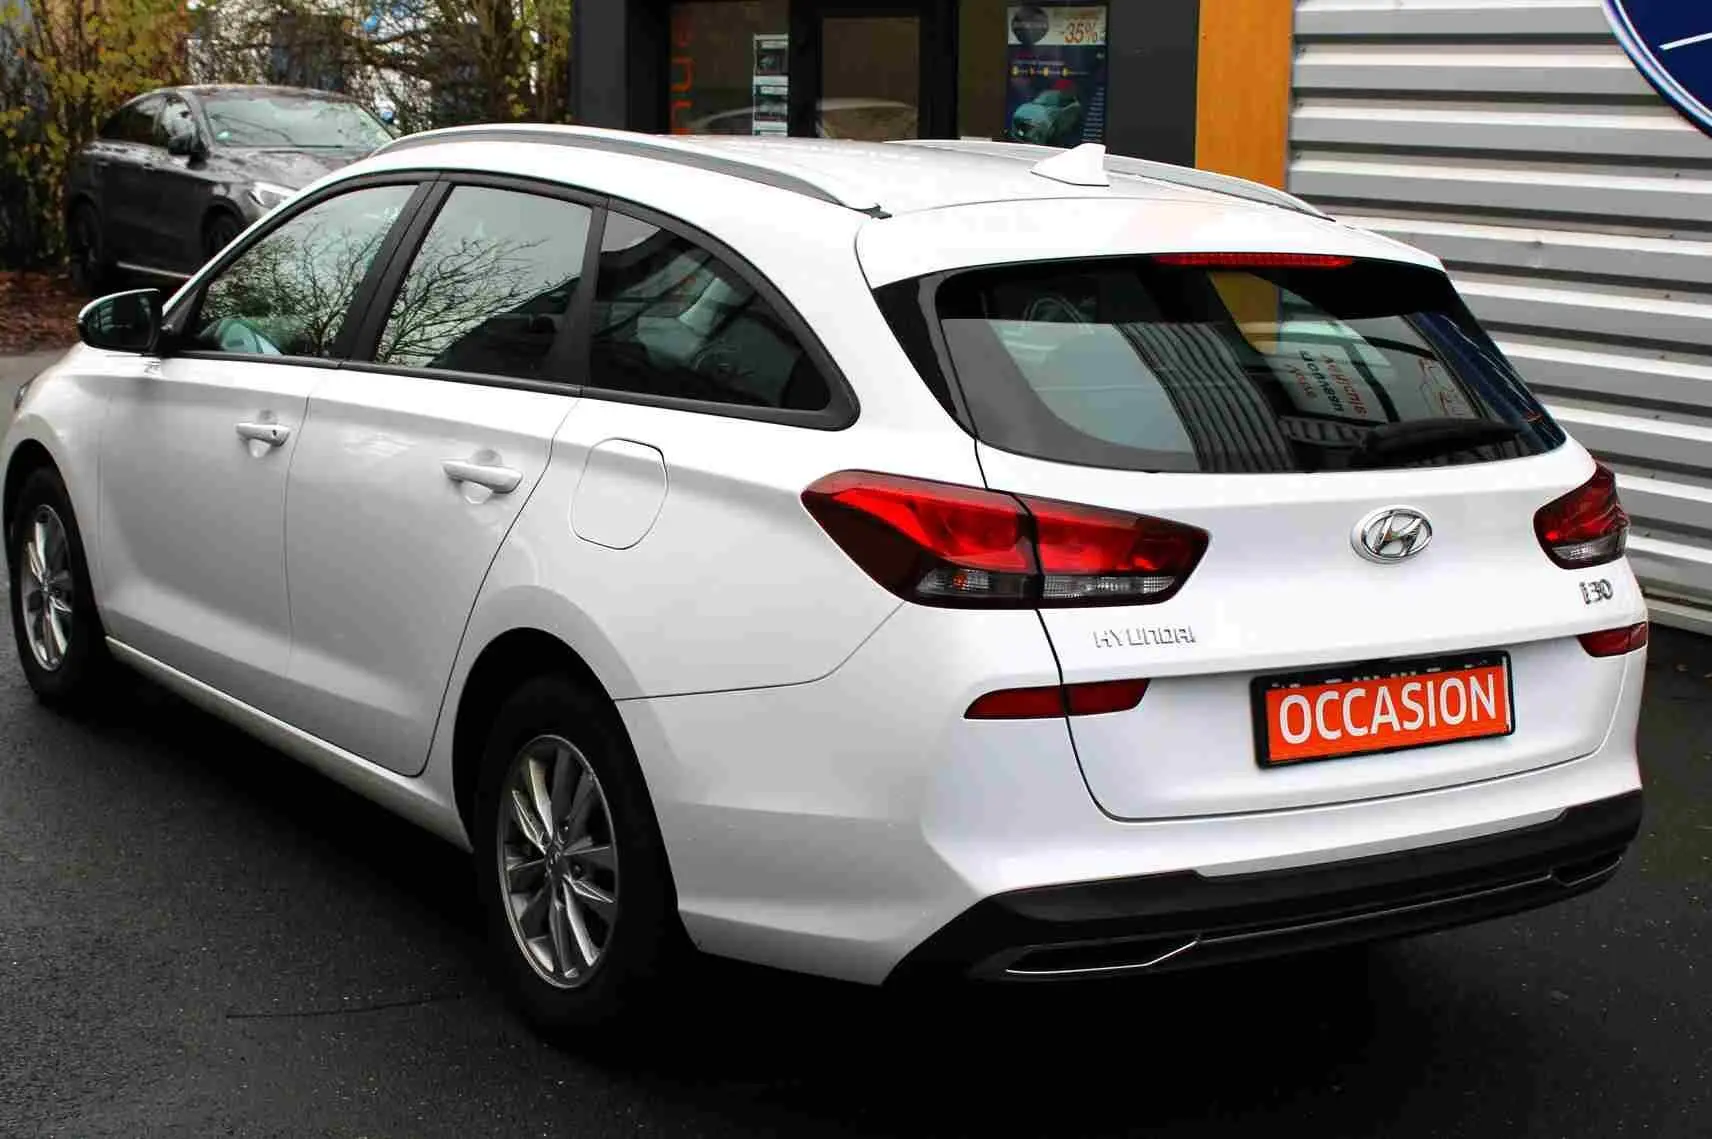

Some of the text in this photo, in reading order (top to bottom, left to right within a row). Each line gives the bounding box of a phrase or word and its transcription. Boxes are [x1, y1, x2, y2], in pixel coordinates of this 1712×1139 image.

[1579, 578, 1614, 606] i30
[1090, 624, 1197, 649] HYUNDAI
[1278, 673, 1498, 745] OCCASION
